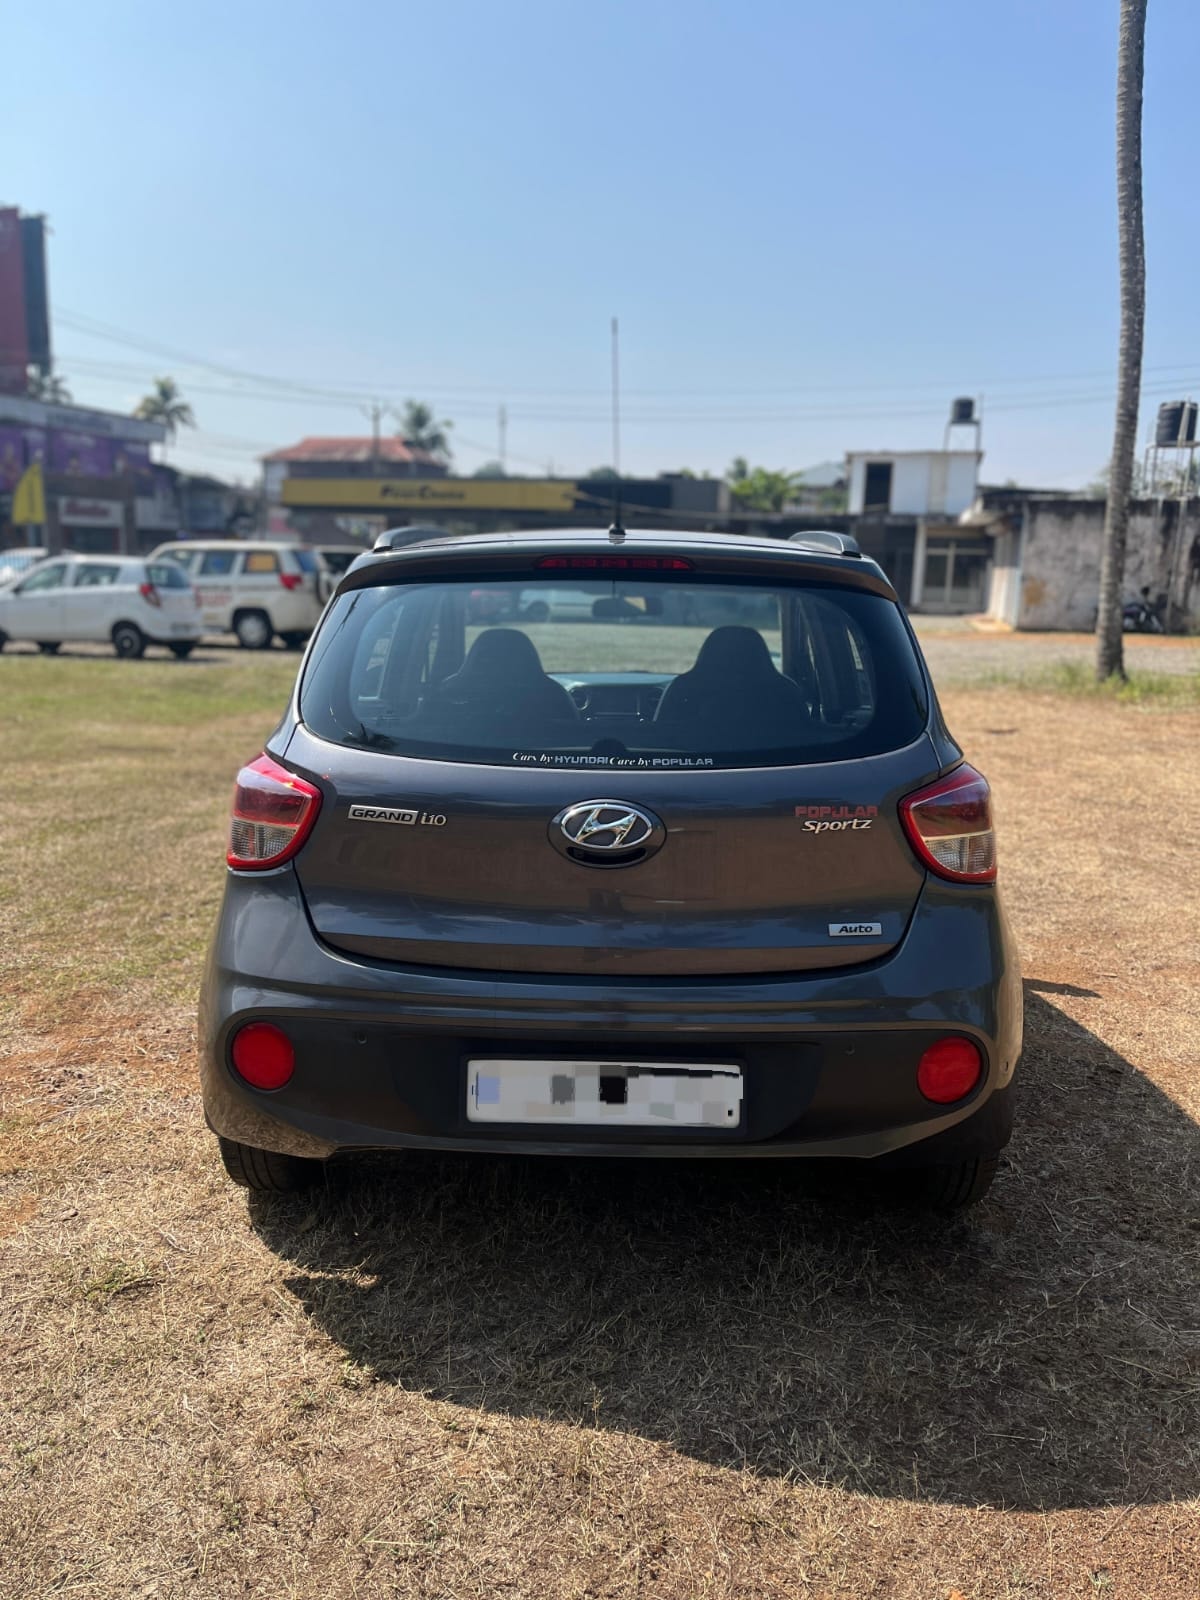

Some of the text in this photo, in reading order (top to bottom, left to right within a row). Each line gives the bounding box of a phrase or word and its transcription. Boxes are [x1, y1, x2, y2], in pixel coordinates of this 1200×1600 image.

[512, 752, 713, 767] Cars by HYUNDAI Care by POPULAR
[352, 808, 447, 826] GRAND i10
[795, 806, 878, 818] POPULAR
[839, 925, 873, 934] Auto
